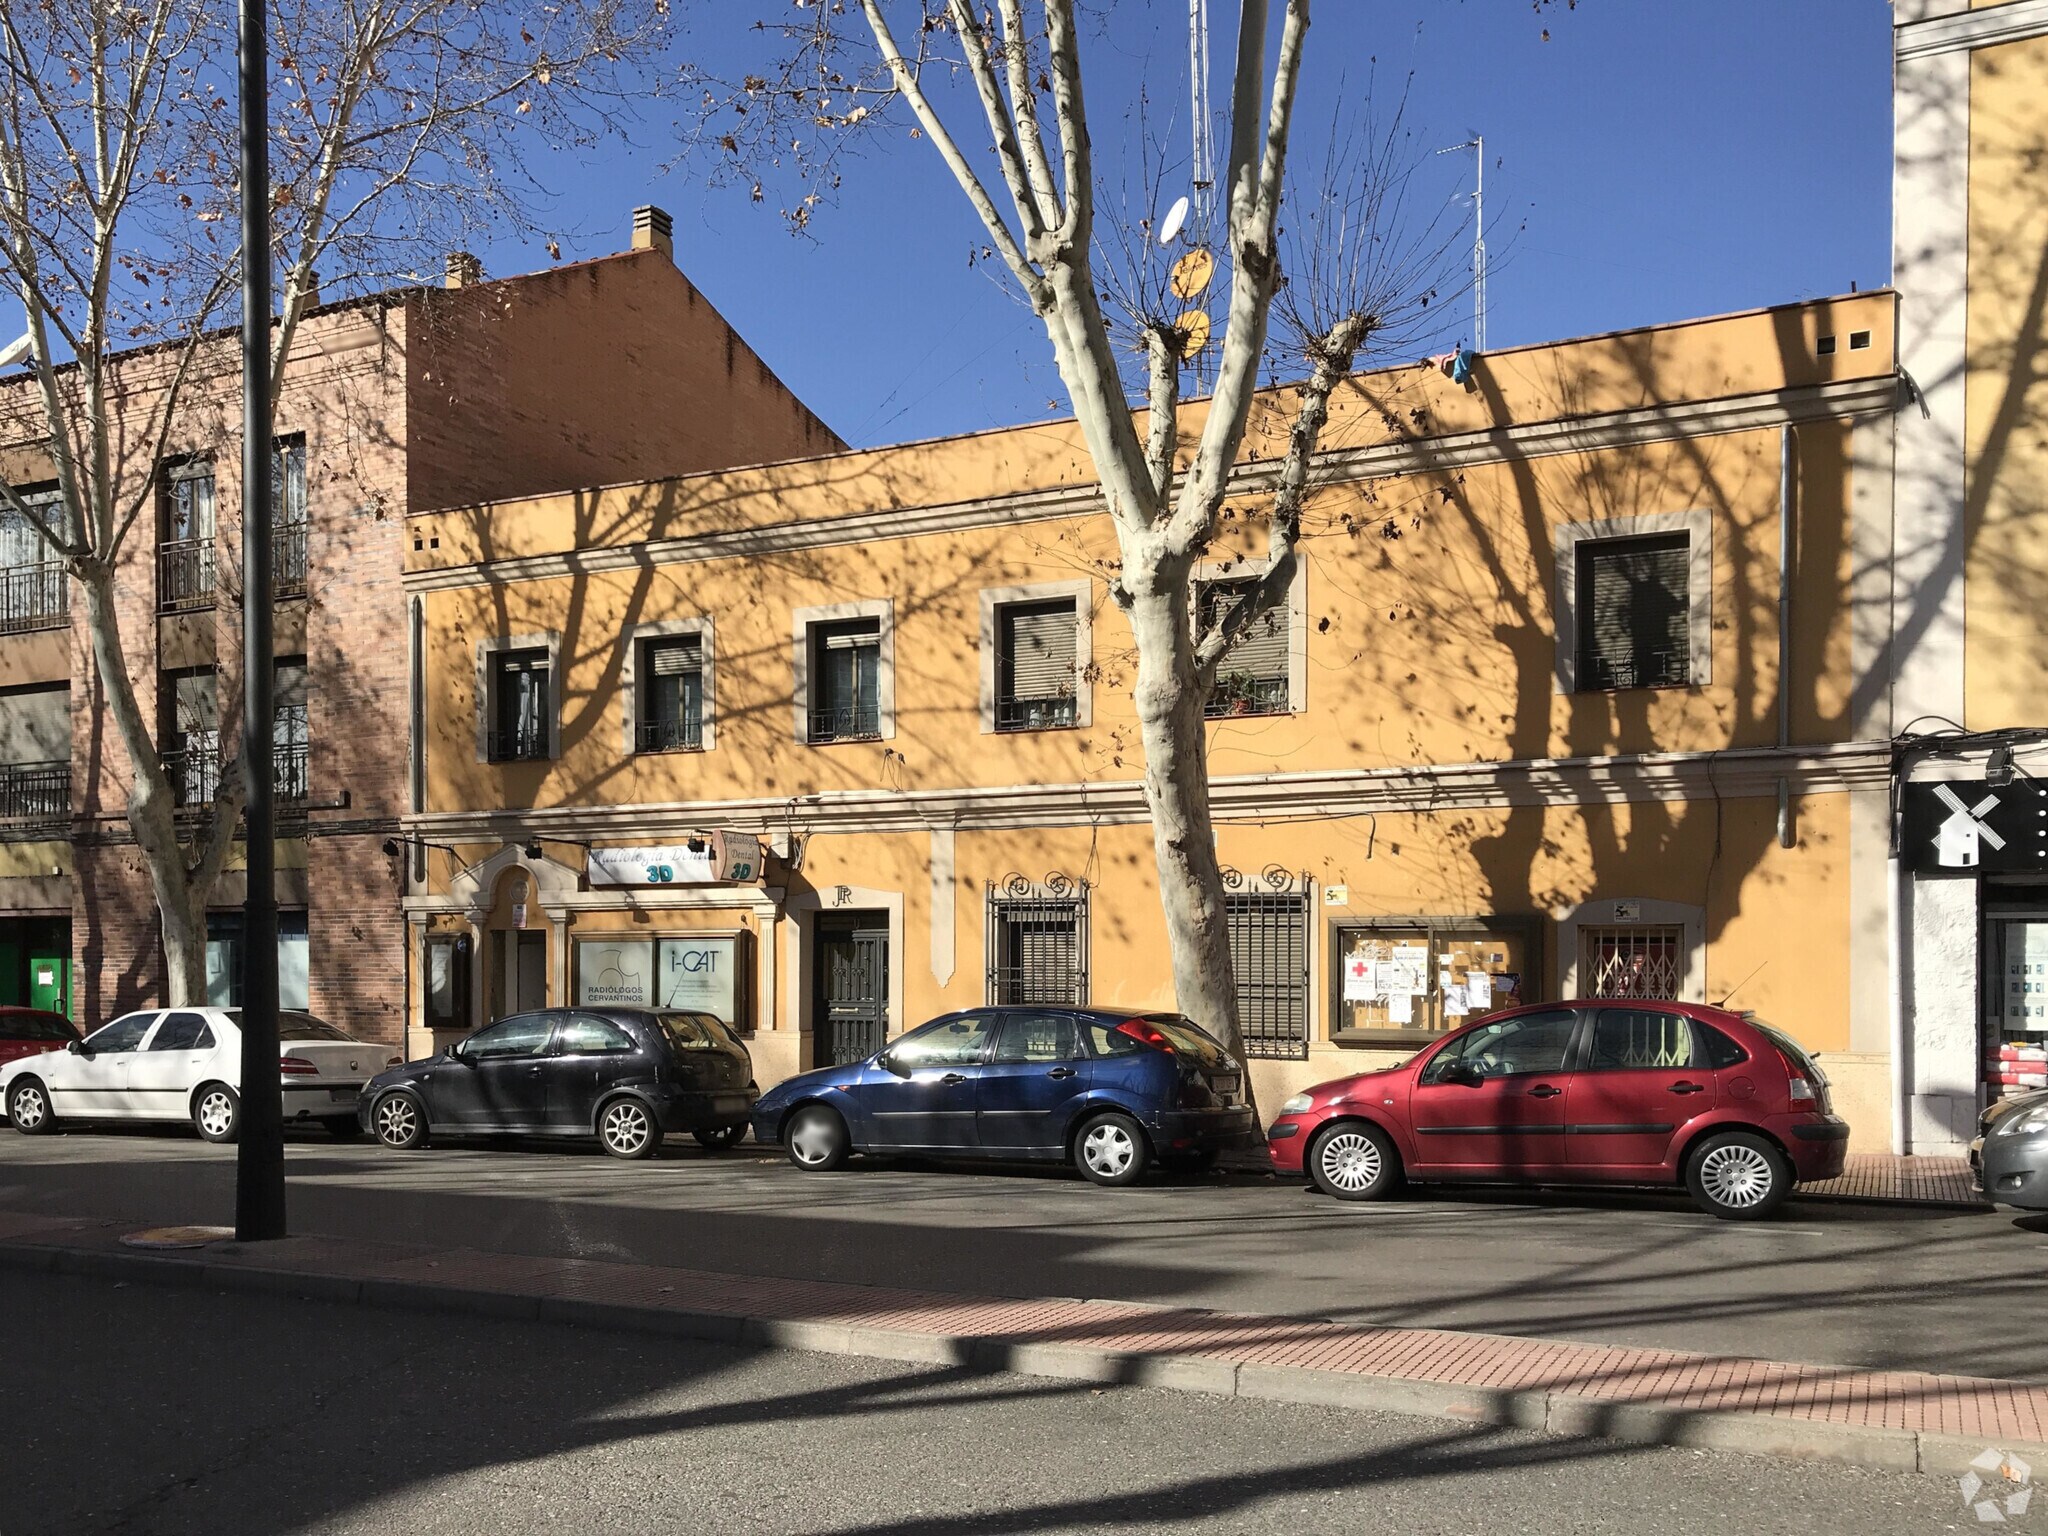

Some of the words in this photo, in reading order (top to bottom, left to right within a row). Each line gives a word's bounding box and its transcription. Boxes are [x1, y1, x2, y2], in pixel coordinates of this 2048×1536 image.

[731, 848, 754, 860] Dental
[646, 865, 674, 882] 3D
[731, 863, 751, 880] 3D
[588, 994, 644, 1002] CERVANTINOS
